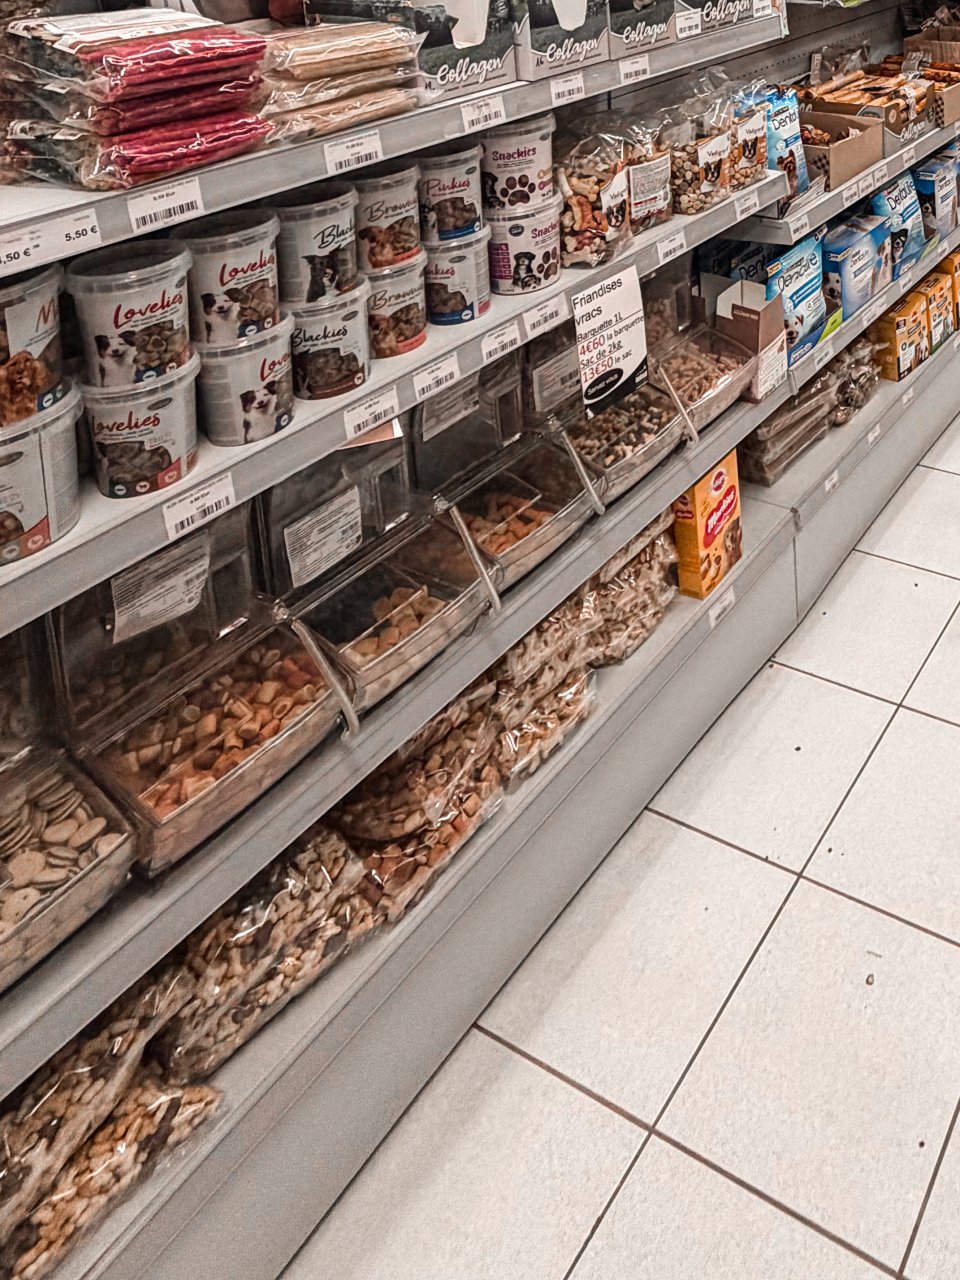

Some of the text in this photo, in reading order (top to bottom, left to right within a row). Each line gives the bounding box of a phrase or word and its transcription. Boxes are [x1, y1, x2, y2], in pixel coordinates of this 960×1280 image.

[622, 20, 668, 44] Collagen
[546, 35, 602, 62] Collagen
[436, 55, 503, 86] Collagen
[491, 145, 538, 163] Snackies
[422, 176, 471, 196] Pinkies
[90, 225, 99, 234] €
[23, 247, 32, 257] €
[426, 263, 456, 278] nkies
[572, 278, 623, 310] Friandises
[113, 290, 184, 330] Lovelies
[575, 306, 603, 326] vracs
[290, 325, 348, 346] Blackies
[577, 311, 624, 343] Barquette 1L
[579, 315, 645, 356] 4€60 la barquette
[580, 340, 623, 370] Sac de 2kg
[582, 348, 633, 384] 13€50 le sac
[259, 356, 291, 382] Love
[92, 410, 162, 436] Lovelies
